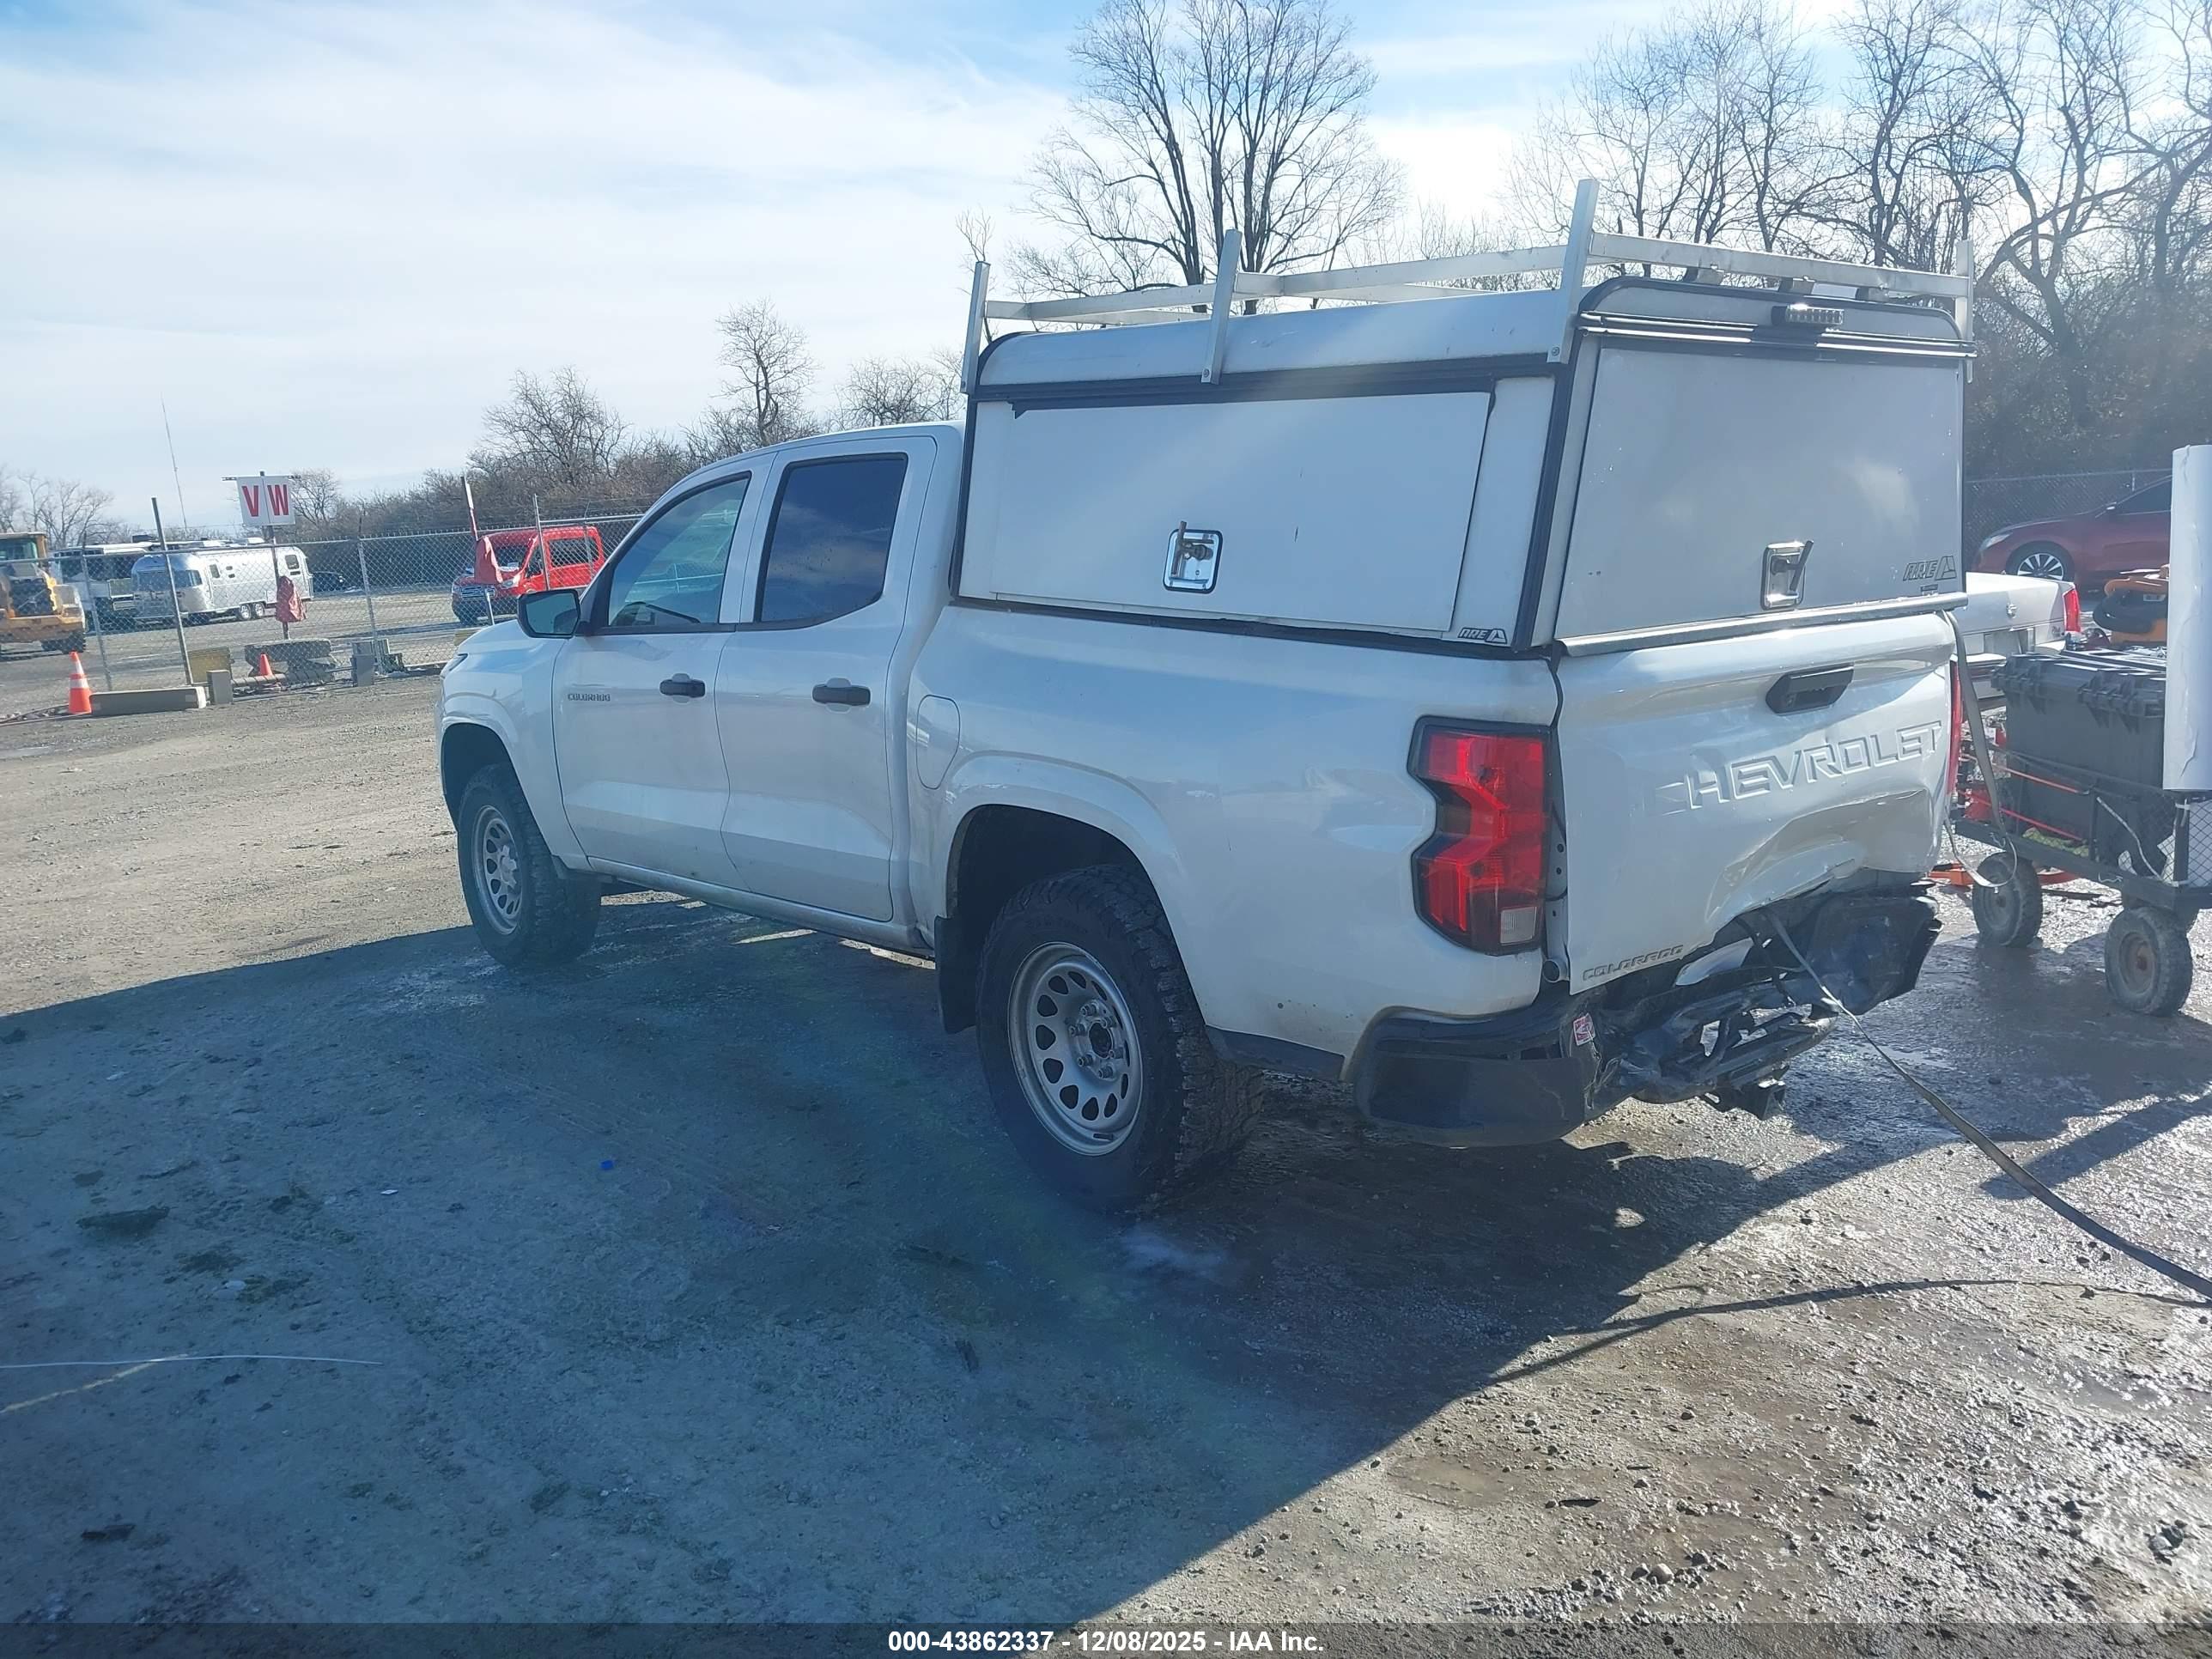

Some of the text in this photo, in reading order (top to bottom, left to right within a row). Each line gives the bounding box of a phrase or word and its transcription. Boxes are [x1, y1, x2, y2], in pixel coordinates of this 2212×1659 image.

[241, 484, 289, 517] V W
[1582, 945, 1683, 981] COLORADO
